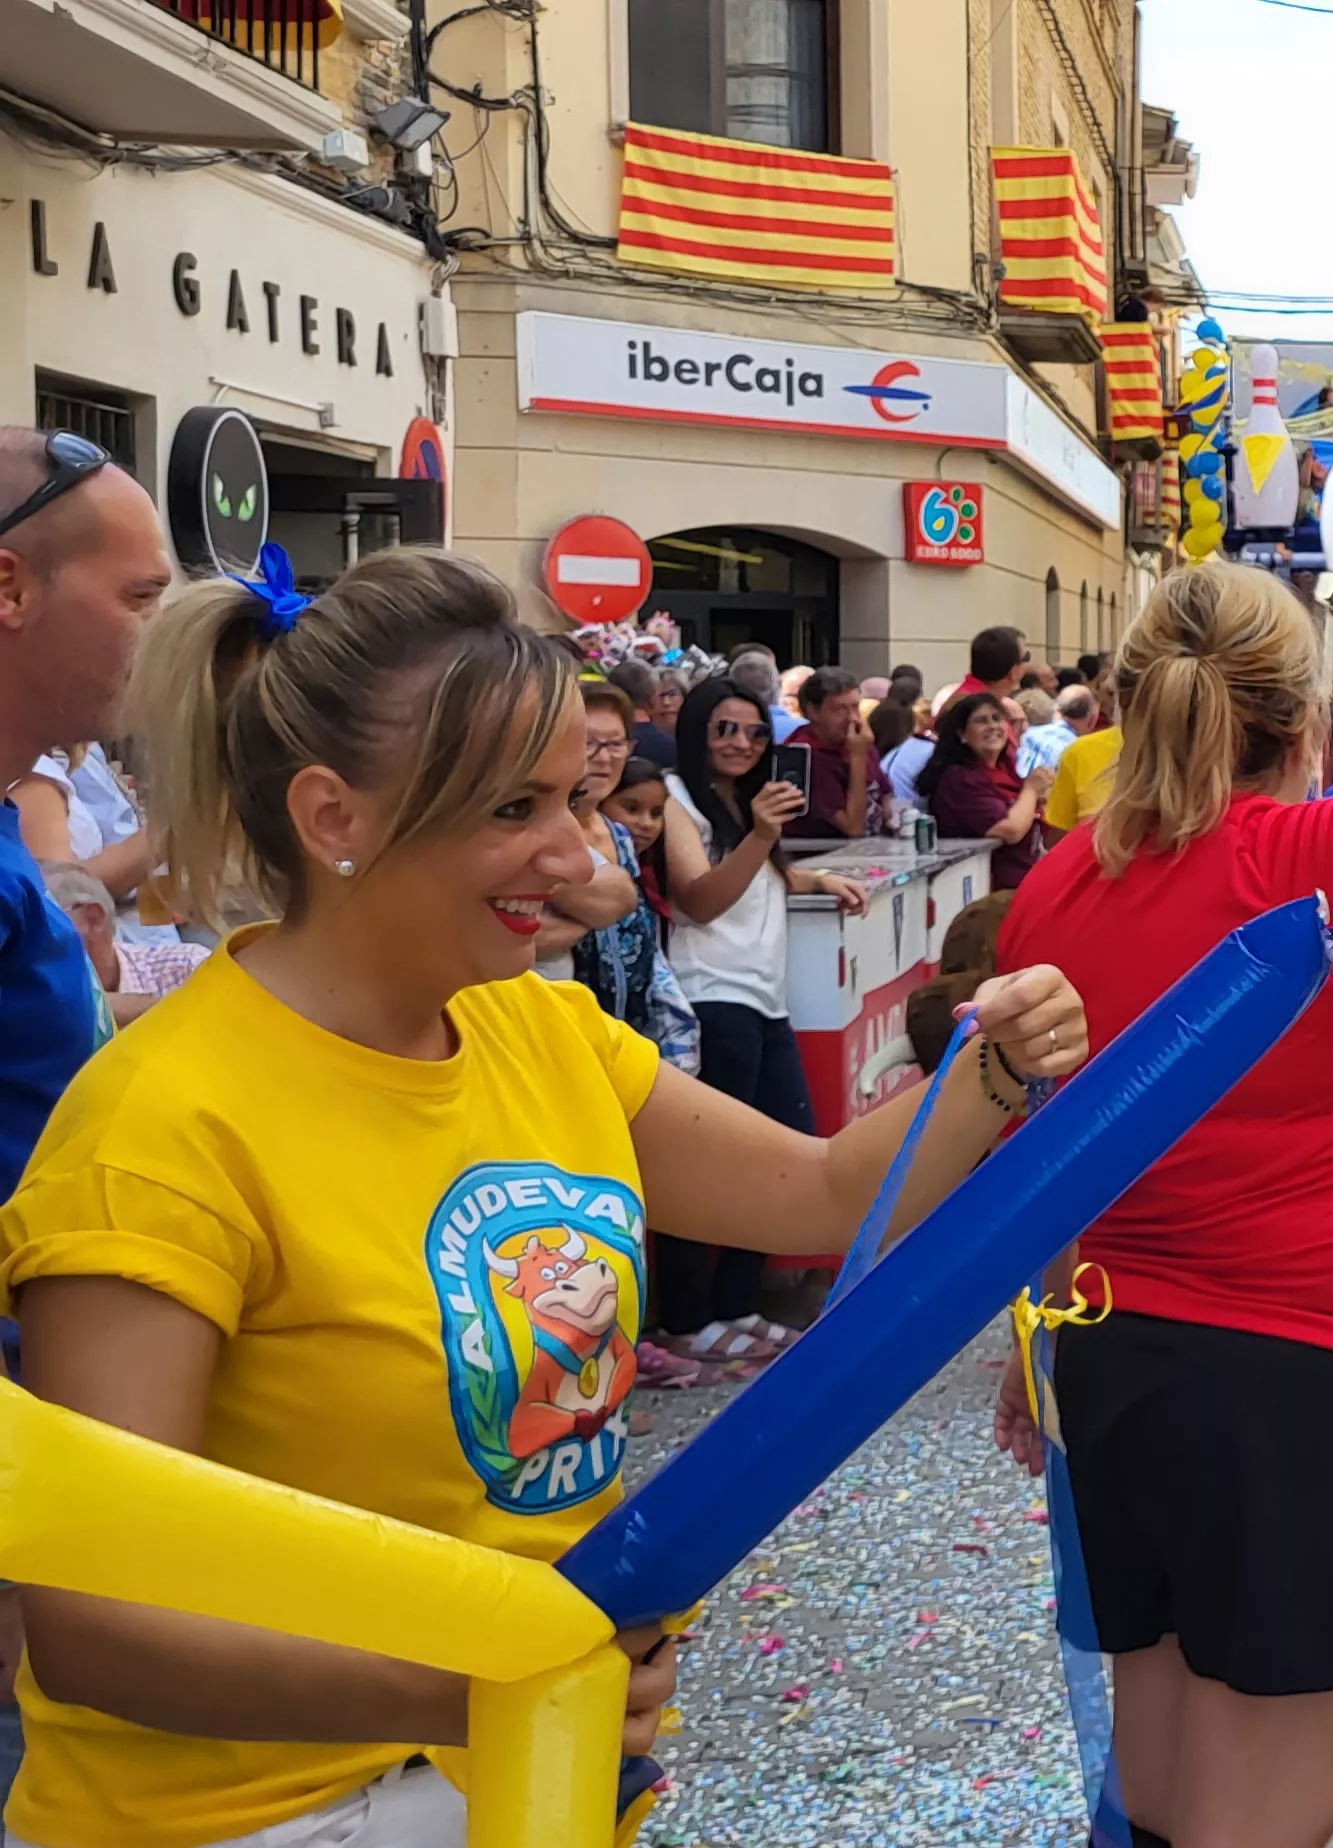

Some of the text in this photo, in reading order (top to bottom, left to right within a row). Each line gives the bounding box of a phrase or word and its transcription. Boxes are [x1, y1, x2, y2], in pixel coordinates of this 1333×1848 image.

[31, 199, 394, 378] LA GATERA
[627, 340, 824, 407] iberCaja
[510, 1402, 628, 1500] PRIX
